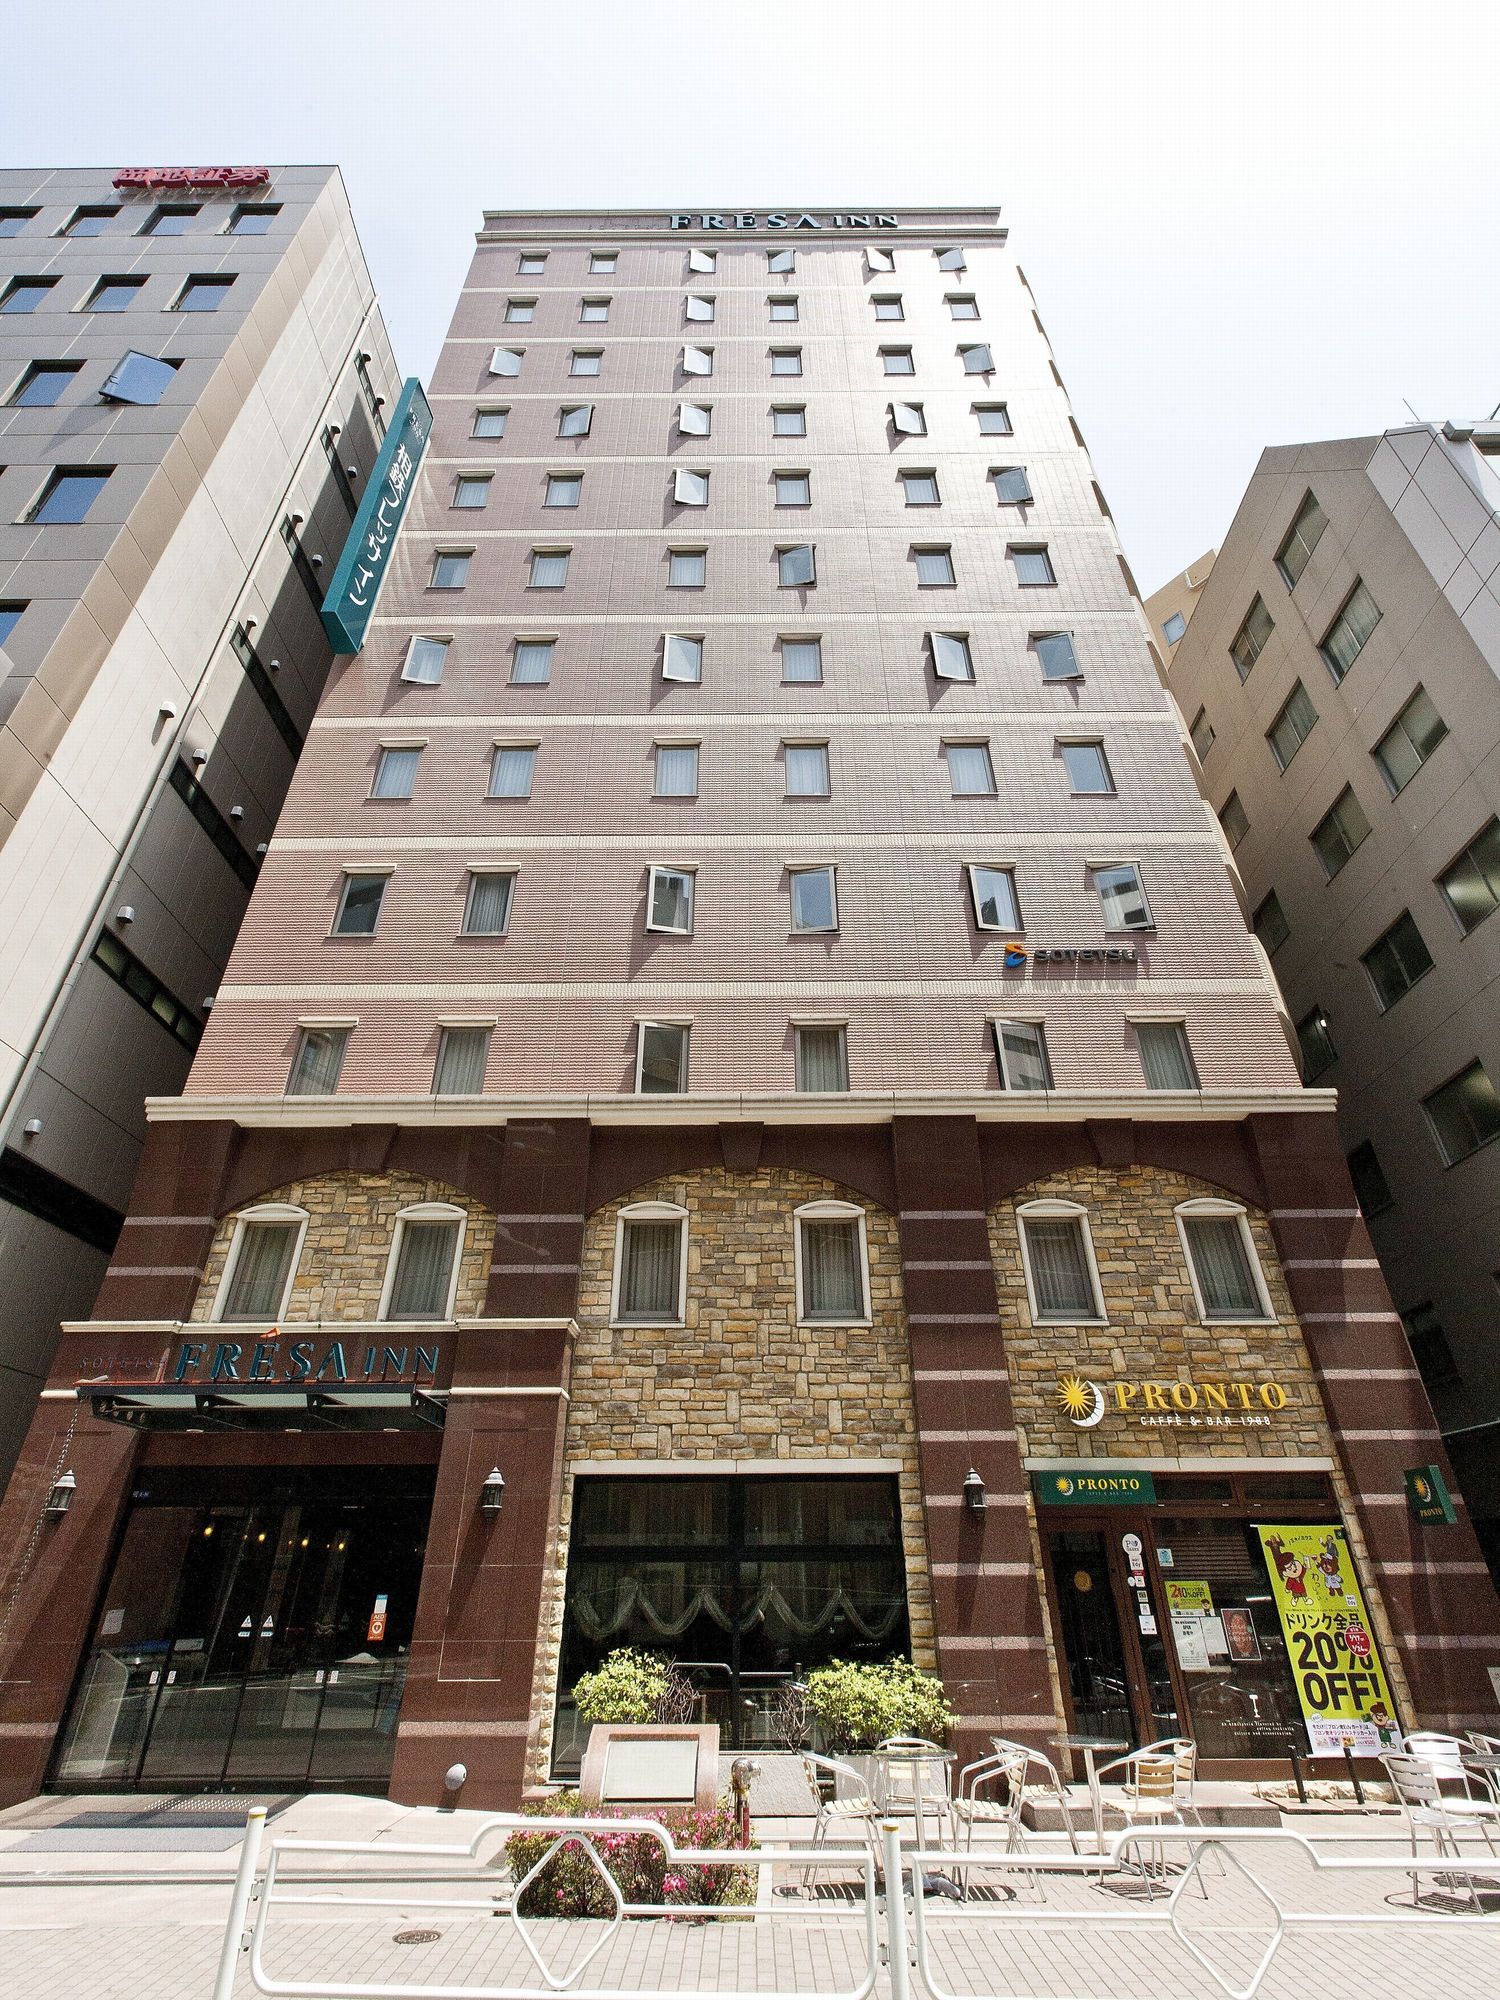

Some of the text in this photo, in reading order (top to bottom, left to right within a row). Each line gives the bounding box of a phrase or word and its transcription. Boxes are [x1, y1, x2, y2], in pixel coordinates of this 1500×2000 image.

[670, 210, 899, 230] FRÉSA INN
[1034, 949, 1138, 963] SOTETSU
[174, 1328, 347, 1381] FRÉSA
[363, 1346, 440, 1376] INN
[1115, 1382, 1287, 1410] PRONTO
[1189, 1416, 1202, 1426] &
[1206, 1416, 1232, 1426] BAR
[1077, 1478, 1140, 1490] PRONTO
[1286, 1613, 1363, 1631] ドリンク全品
[1292, 1631, 1374, 1670] 20%
[1303, 1672, 1382, 1711] OFF!
